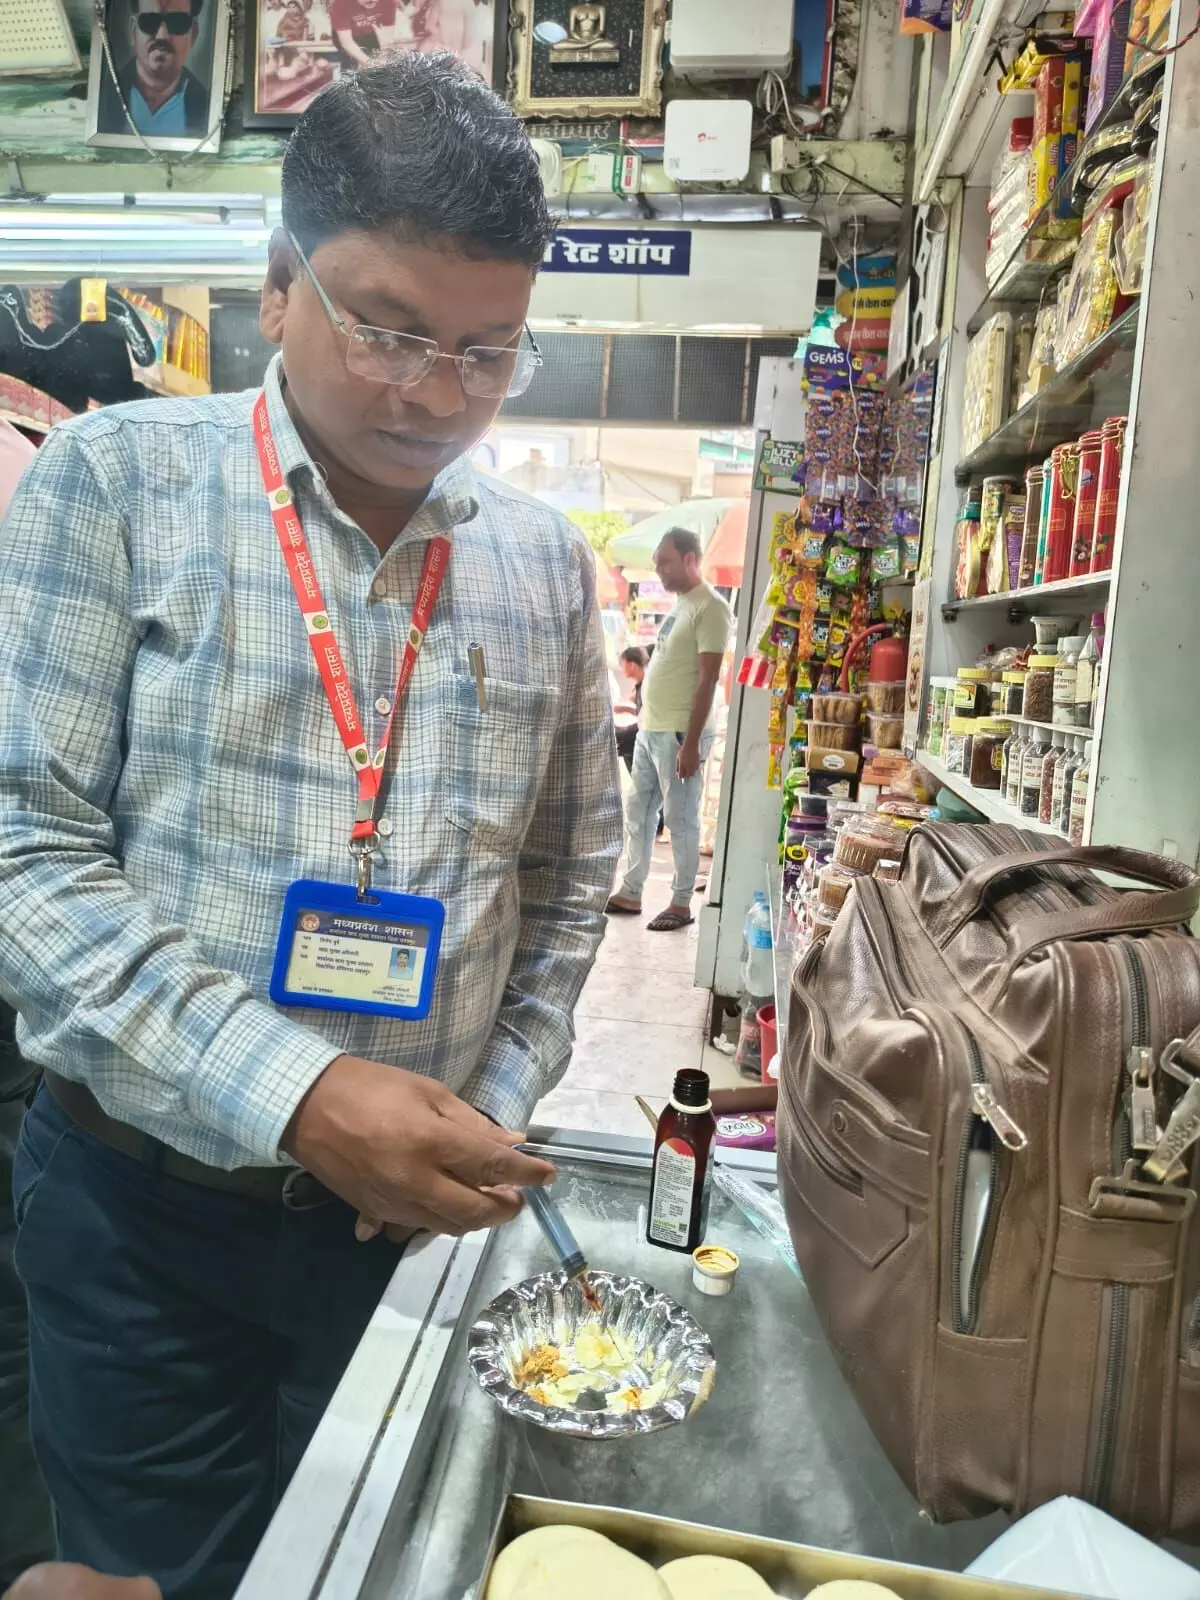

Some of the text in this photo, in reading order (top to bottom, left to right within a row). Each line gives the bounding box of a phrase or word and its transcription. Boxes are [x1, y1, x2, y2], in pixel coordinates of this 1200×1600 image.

[556, 236, 602, 263] रेट
[608, 238, 675, 265] शॉप
[809, 349, 845, 364] GEMS
[285, 519, 317, 599] मध्यप्रदेश शासन
[429, 547, 442, 577] शासन
[324, 646, 355, 732] मध्यप्रदेश शासन
[333, 918, 378, 933] मध्यप्रदेश
[384, 925, 414, 937] शासन
